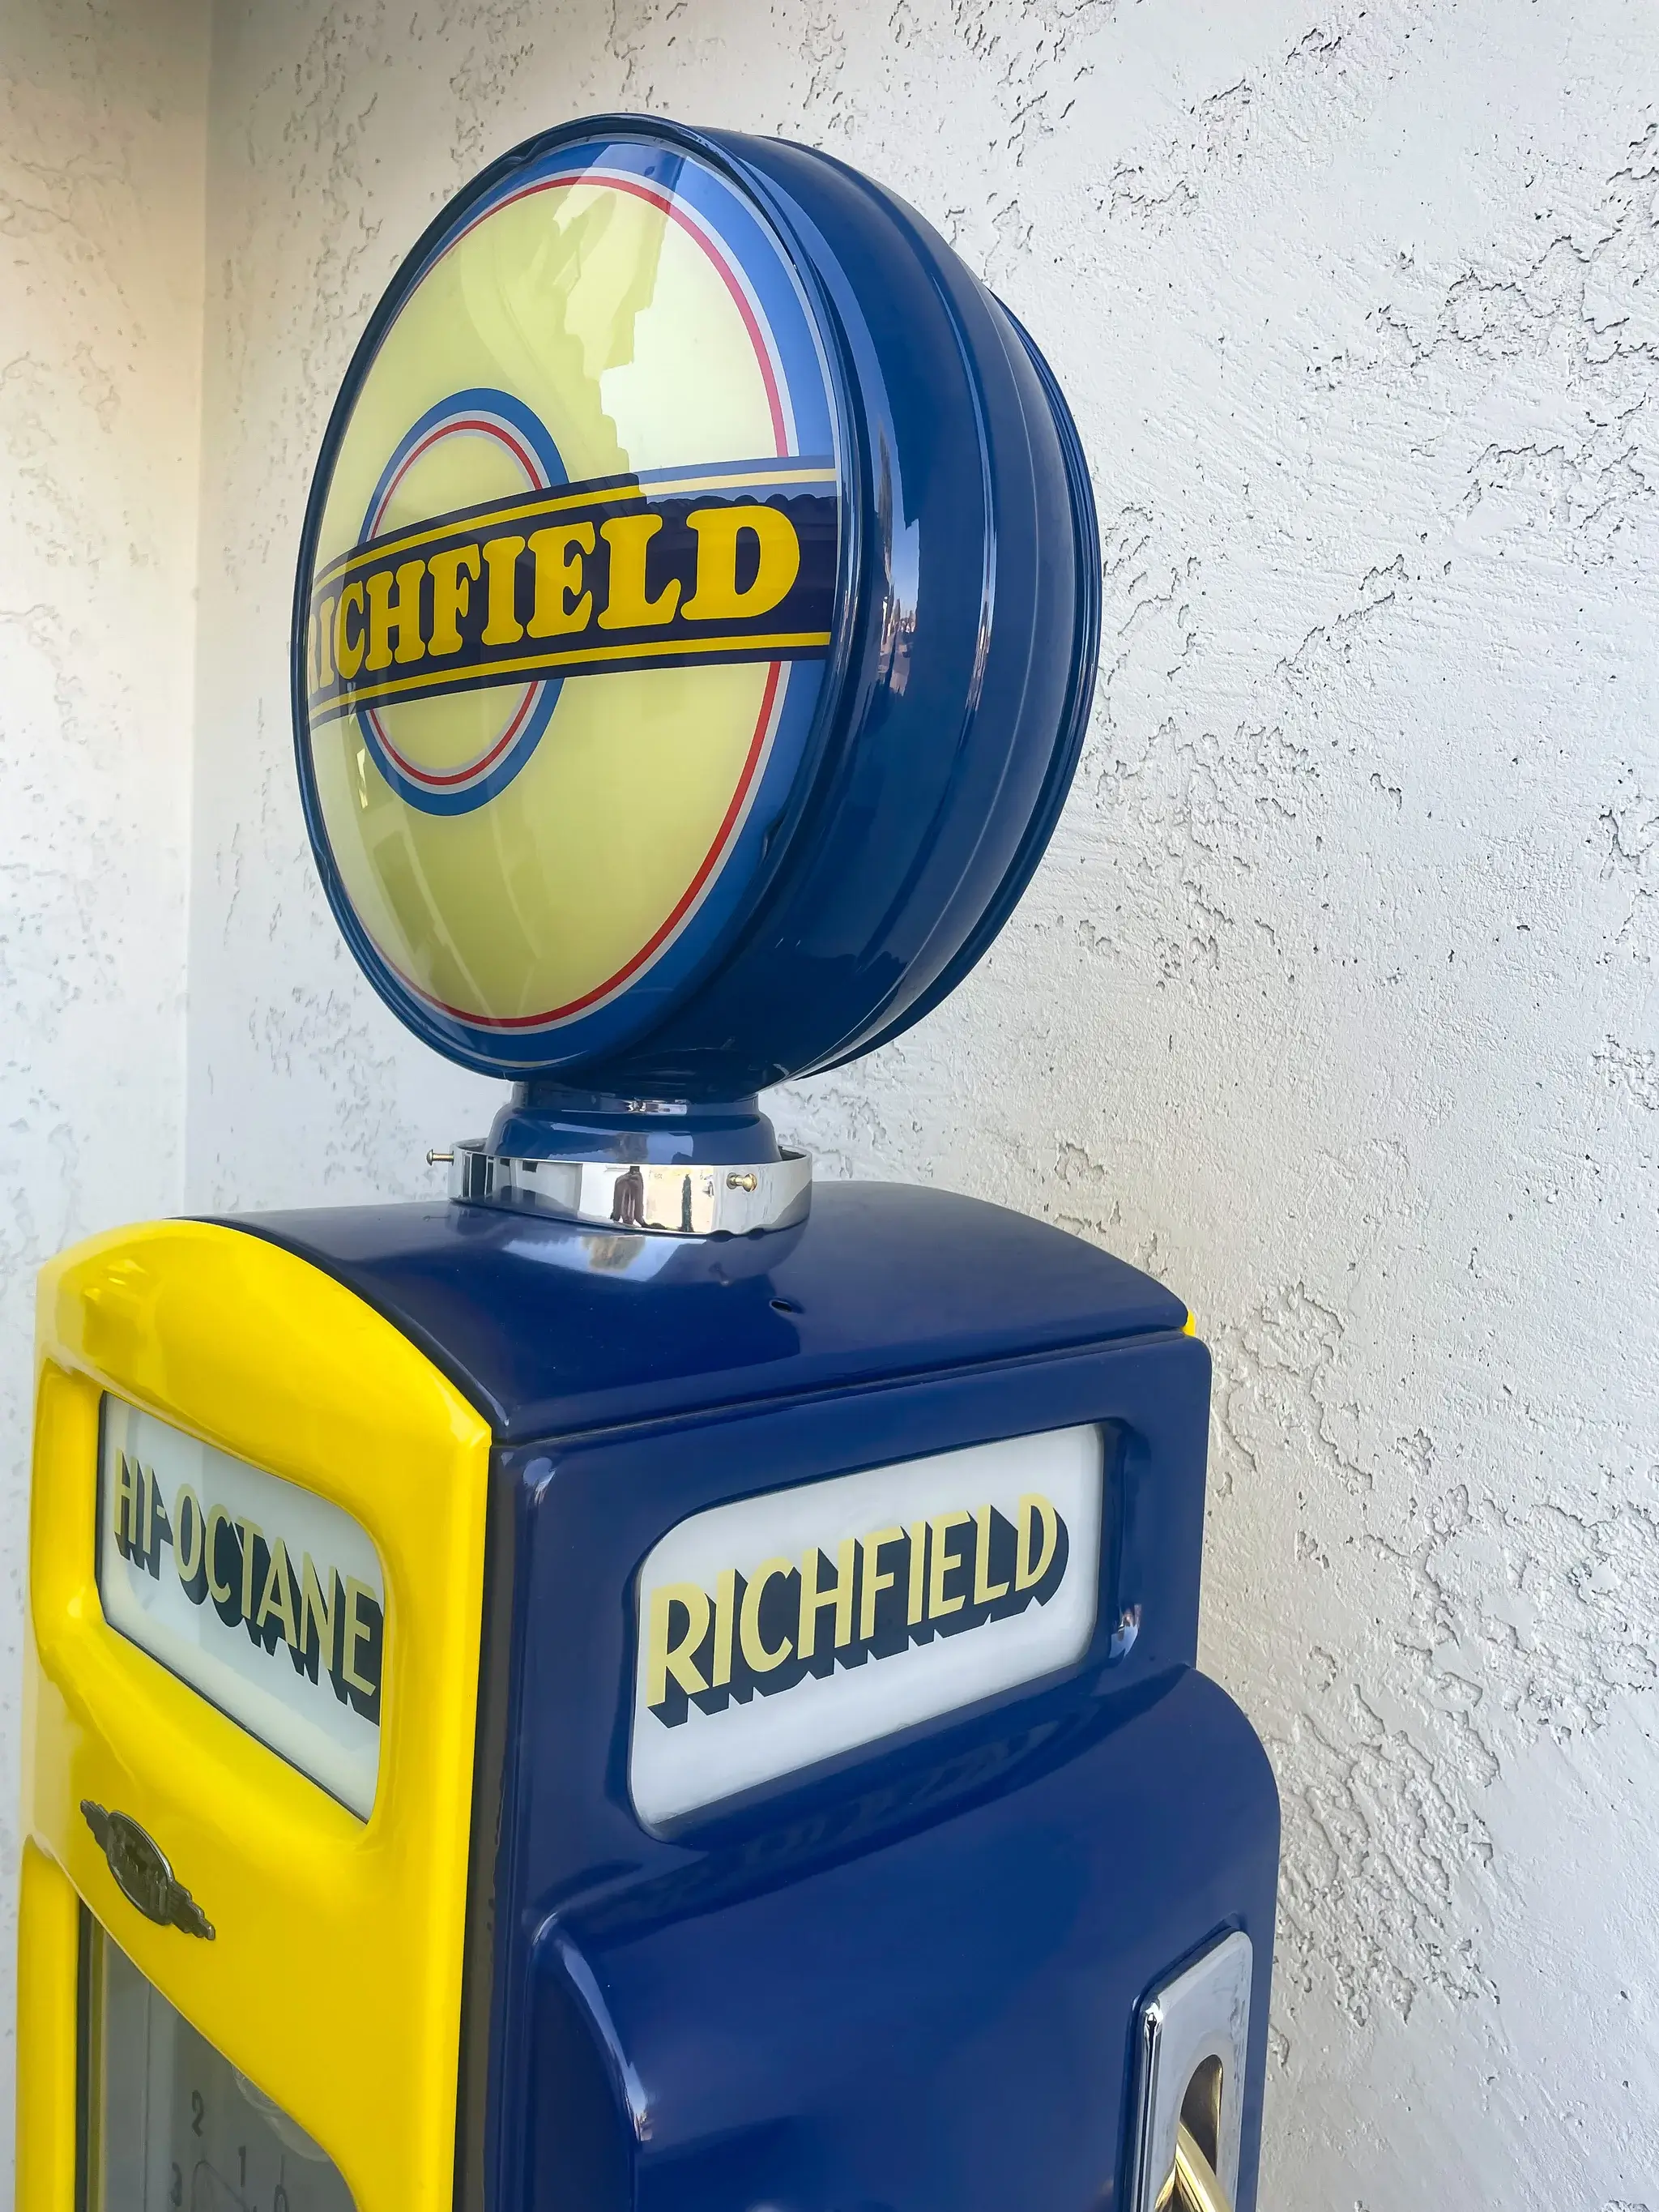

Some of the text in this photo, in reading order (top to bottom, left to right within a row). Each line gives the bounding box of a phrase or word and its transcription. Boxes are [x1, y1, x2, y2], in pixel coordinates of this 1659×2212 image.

[113, 1448, 383, 1727] HI-OCTANE
[648, 1492, 1069, 1728] RICHFIELD
[191, 2090, 204, 2137] 2
